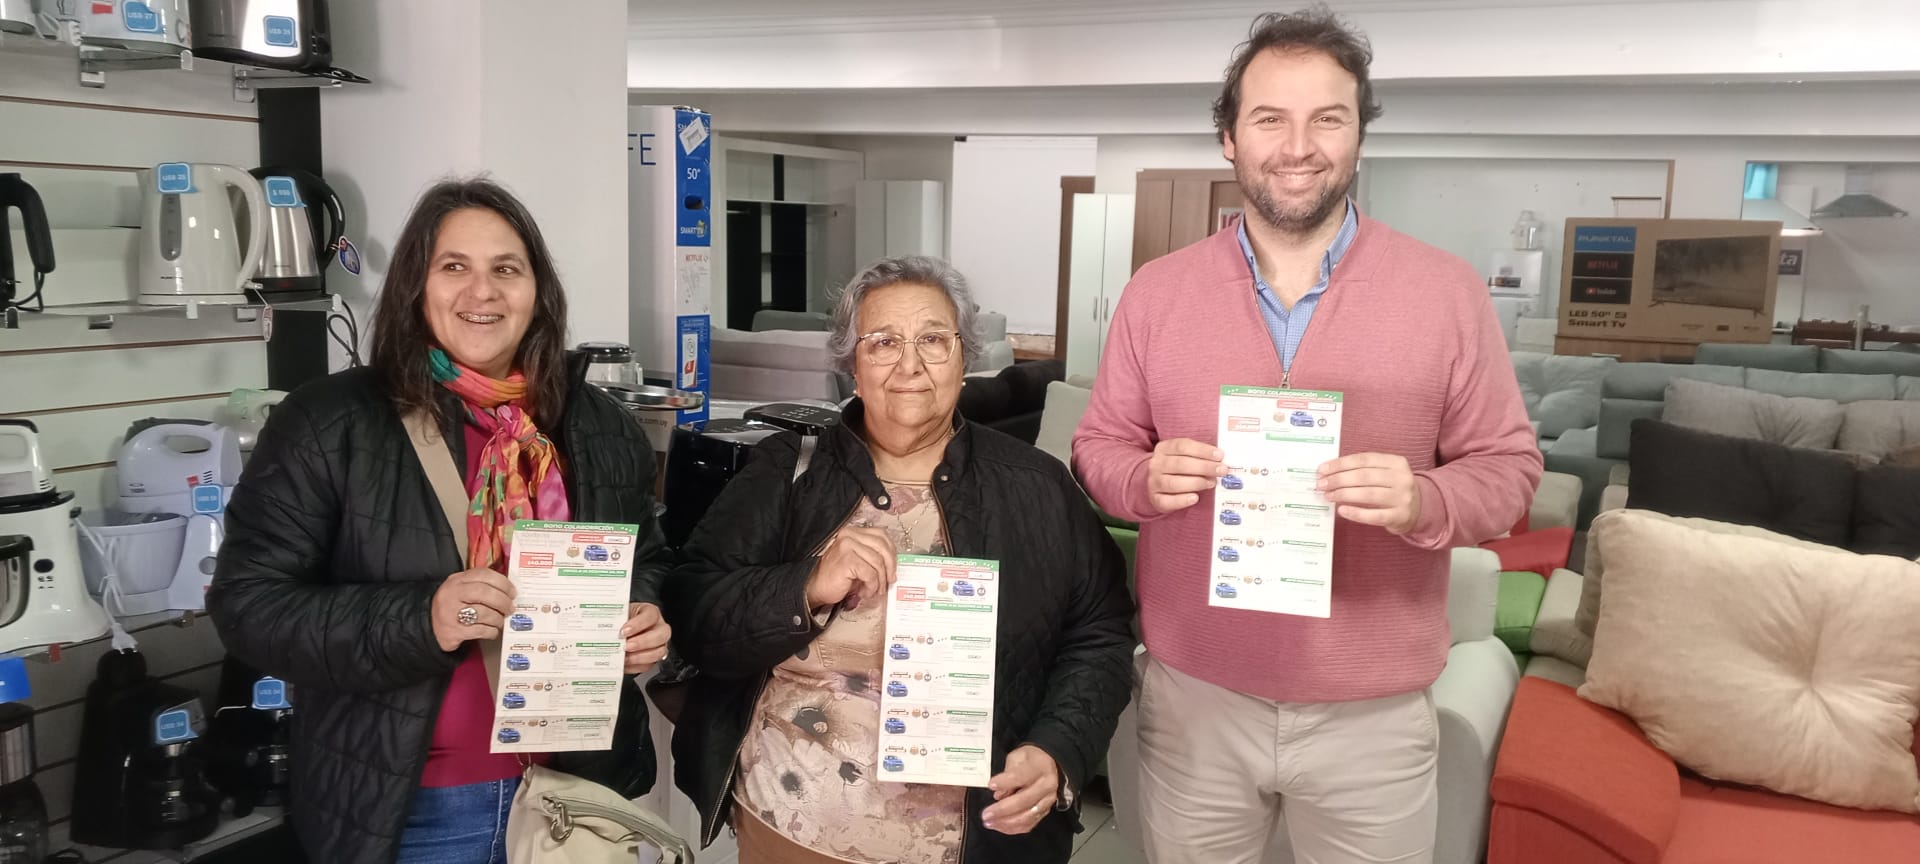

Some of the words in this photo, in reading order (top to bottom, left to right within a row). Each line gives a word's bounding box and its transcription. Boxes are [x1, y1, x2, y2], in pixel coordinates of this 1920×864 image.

[1577, 234, 1632, 243] PUNKTAL
[1569, 310, 1588, 318] LED
[1568, 319, 1607, 328] Smart
